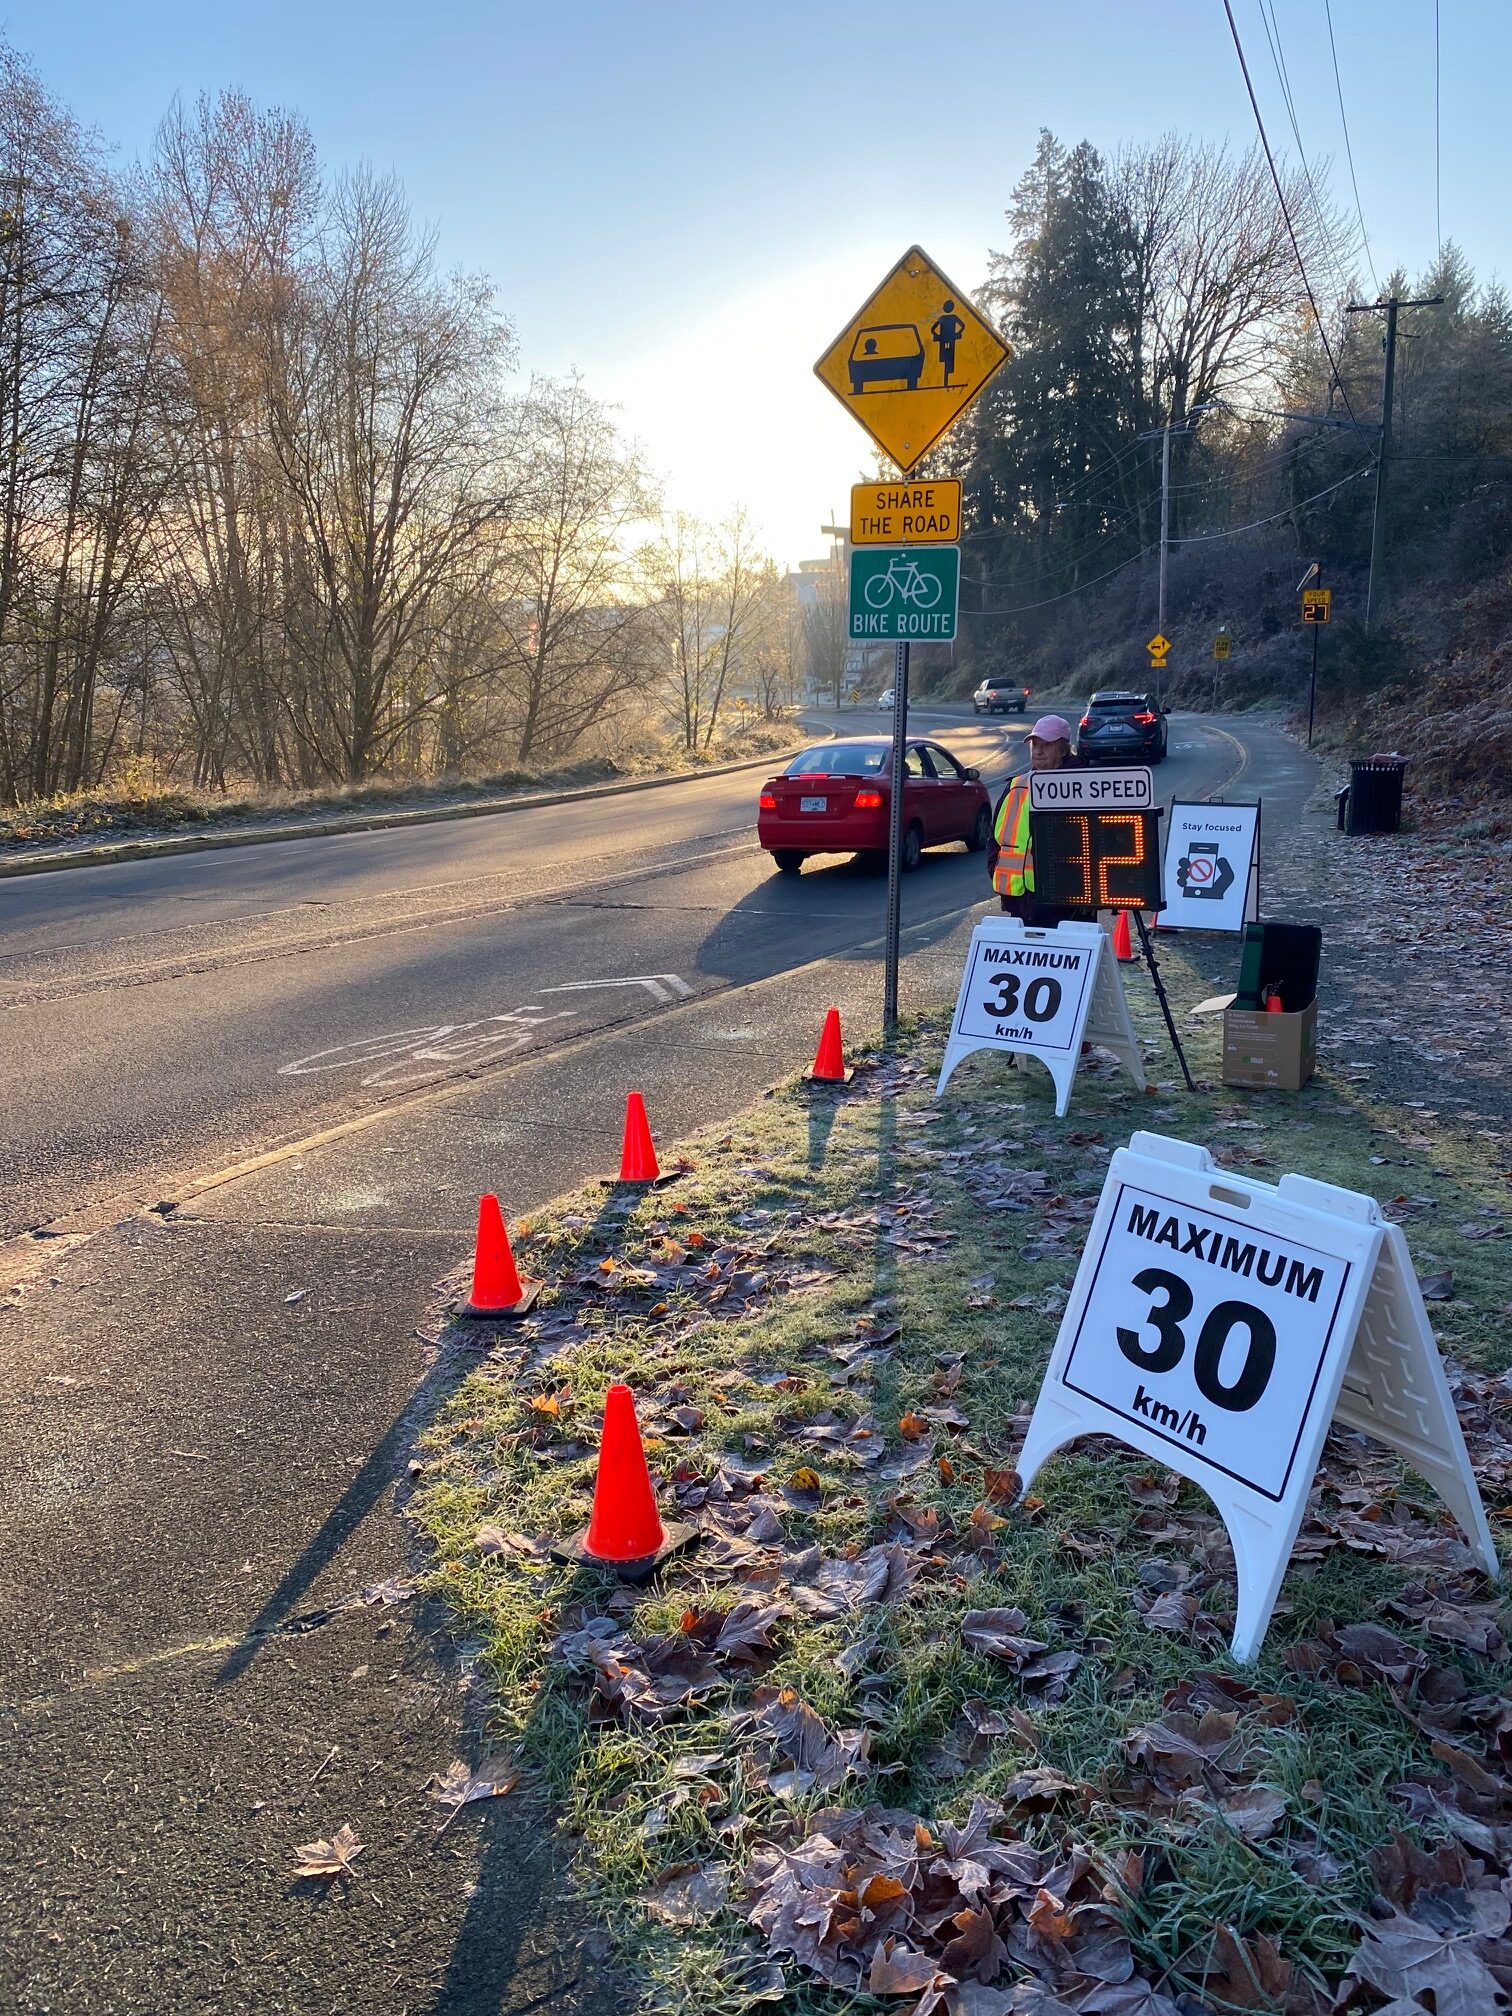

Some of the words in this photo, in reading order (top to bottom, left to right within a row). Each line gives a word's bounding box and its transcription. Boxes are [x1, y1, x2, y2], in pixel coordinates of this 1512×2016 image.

[876, 490, 935, 510] SHARE
[860, 517, 892, 535] THE
[902, 514, 950, 533] ROAD
[853, 614, 889, 633] BIKE
[897, 613, 951, 633] ROUTE
[1304, 604, 1328, 621] 27
[1034, 782, 1083, 800] YOUR
[1089, 780, 1148, 798] SPEED
[1182, 822, 1203, 833] Stay
[1205, 823, 1242, 832] focused
[1056, 815, 1145, 906] 32
[983, 948, 1081, 970] MAXIMUM
[983, 973, 1062, 1023] 30
[995, 1024, 1033, 1040] km/h
[1126, 1203, 1325, 1303] MAXIMUM
[1116, 1267, 1277, 1412] 30
[1131, 1384, 1207, 1446] km/h
